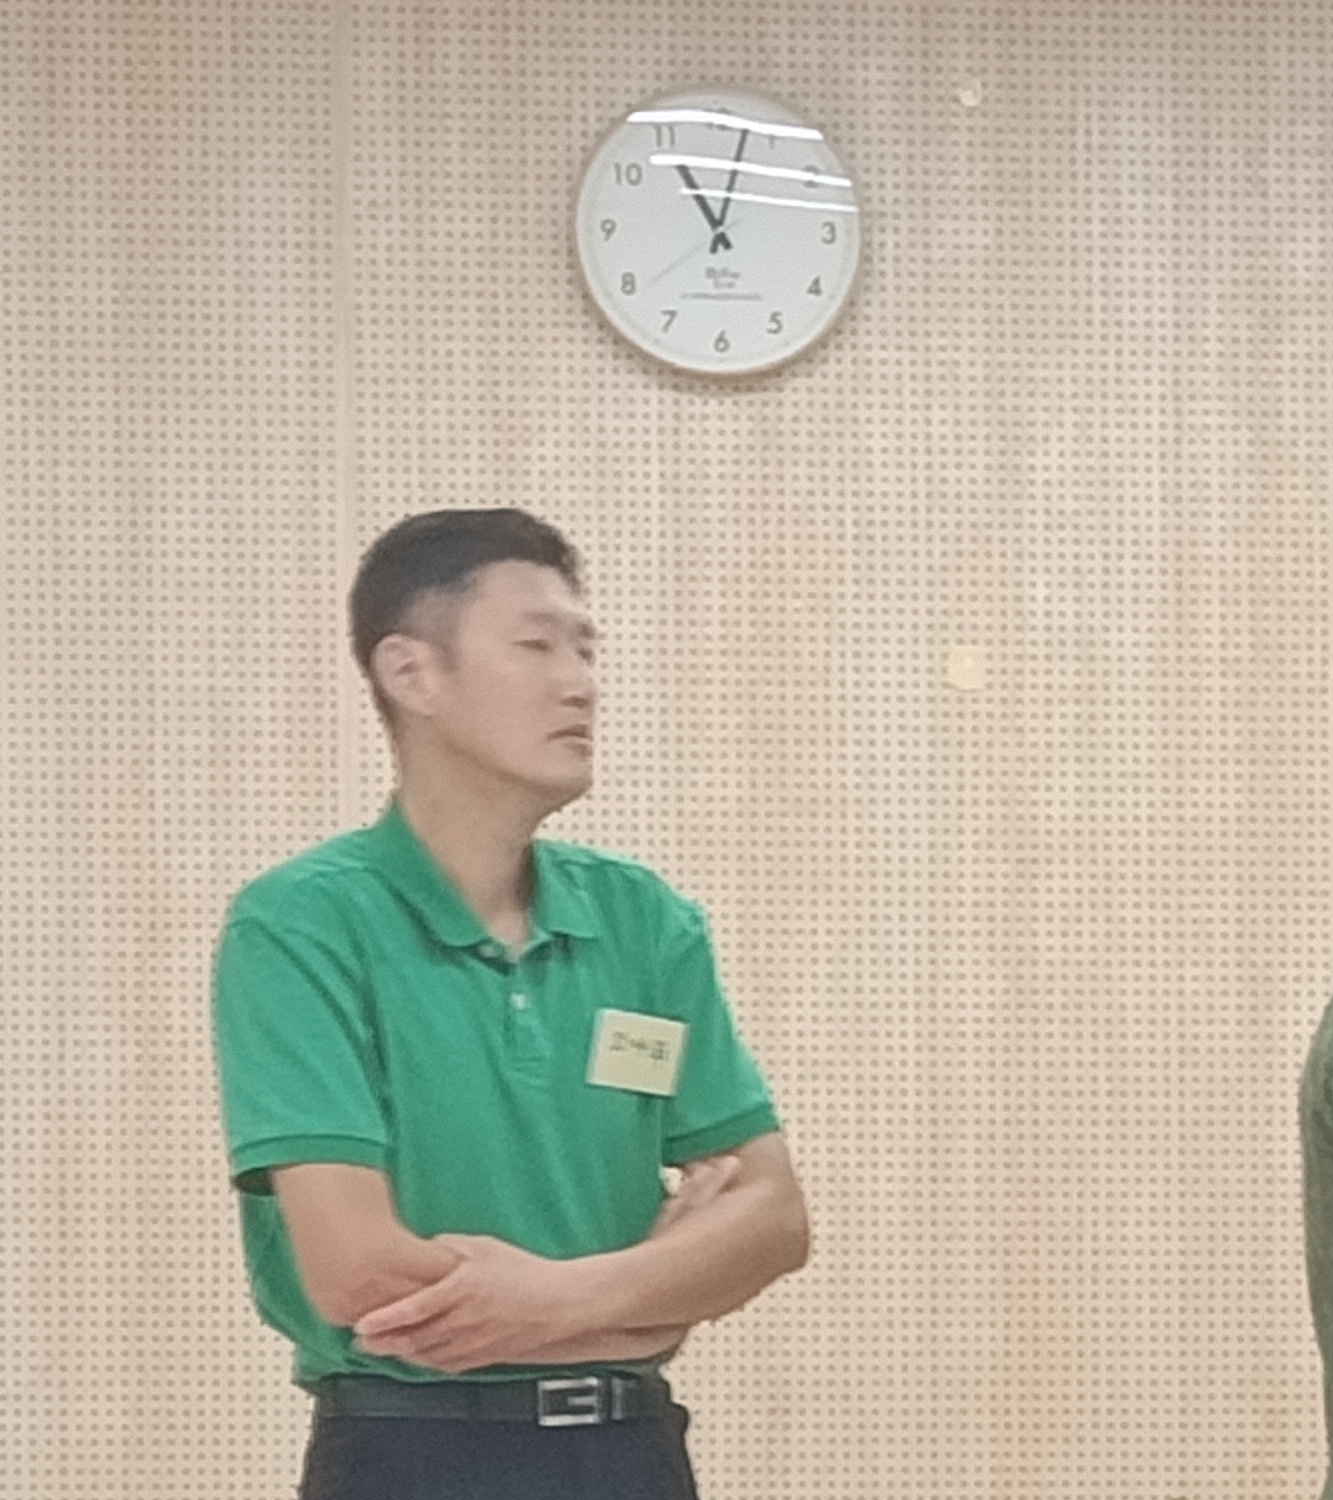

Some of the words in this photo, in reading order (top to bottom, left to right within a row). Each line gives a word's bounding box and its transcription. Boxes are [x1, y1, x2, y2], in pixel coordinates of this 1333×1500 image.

[655, 124, 676, 148] 11
[614, 162, 643, 186] 10
[600, 218, 617, 241] 9
[821, 221, 837, 245] 3
[620, 271, 637, 296] 8
[806, 275, 823, 297] 4
[661, 309, 678, 333] 7
[766, 310, 784, 334] 5
[713, 329, 731, 353] 6
